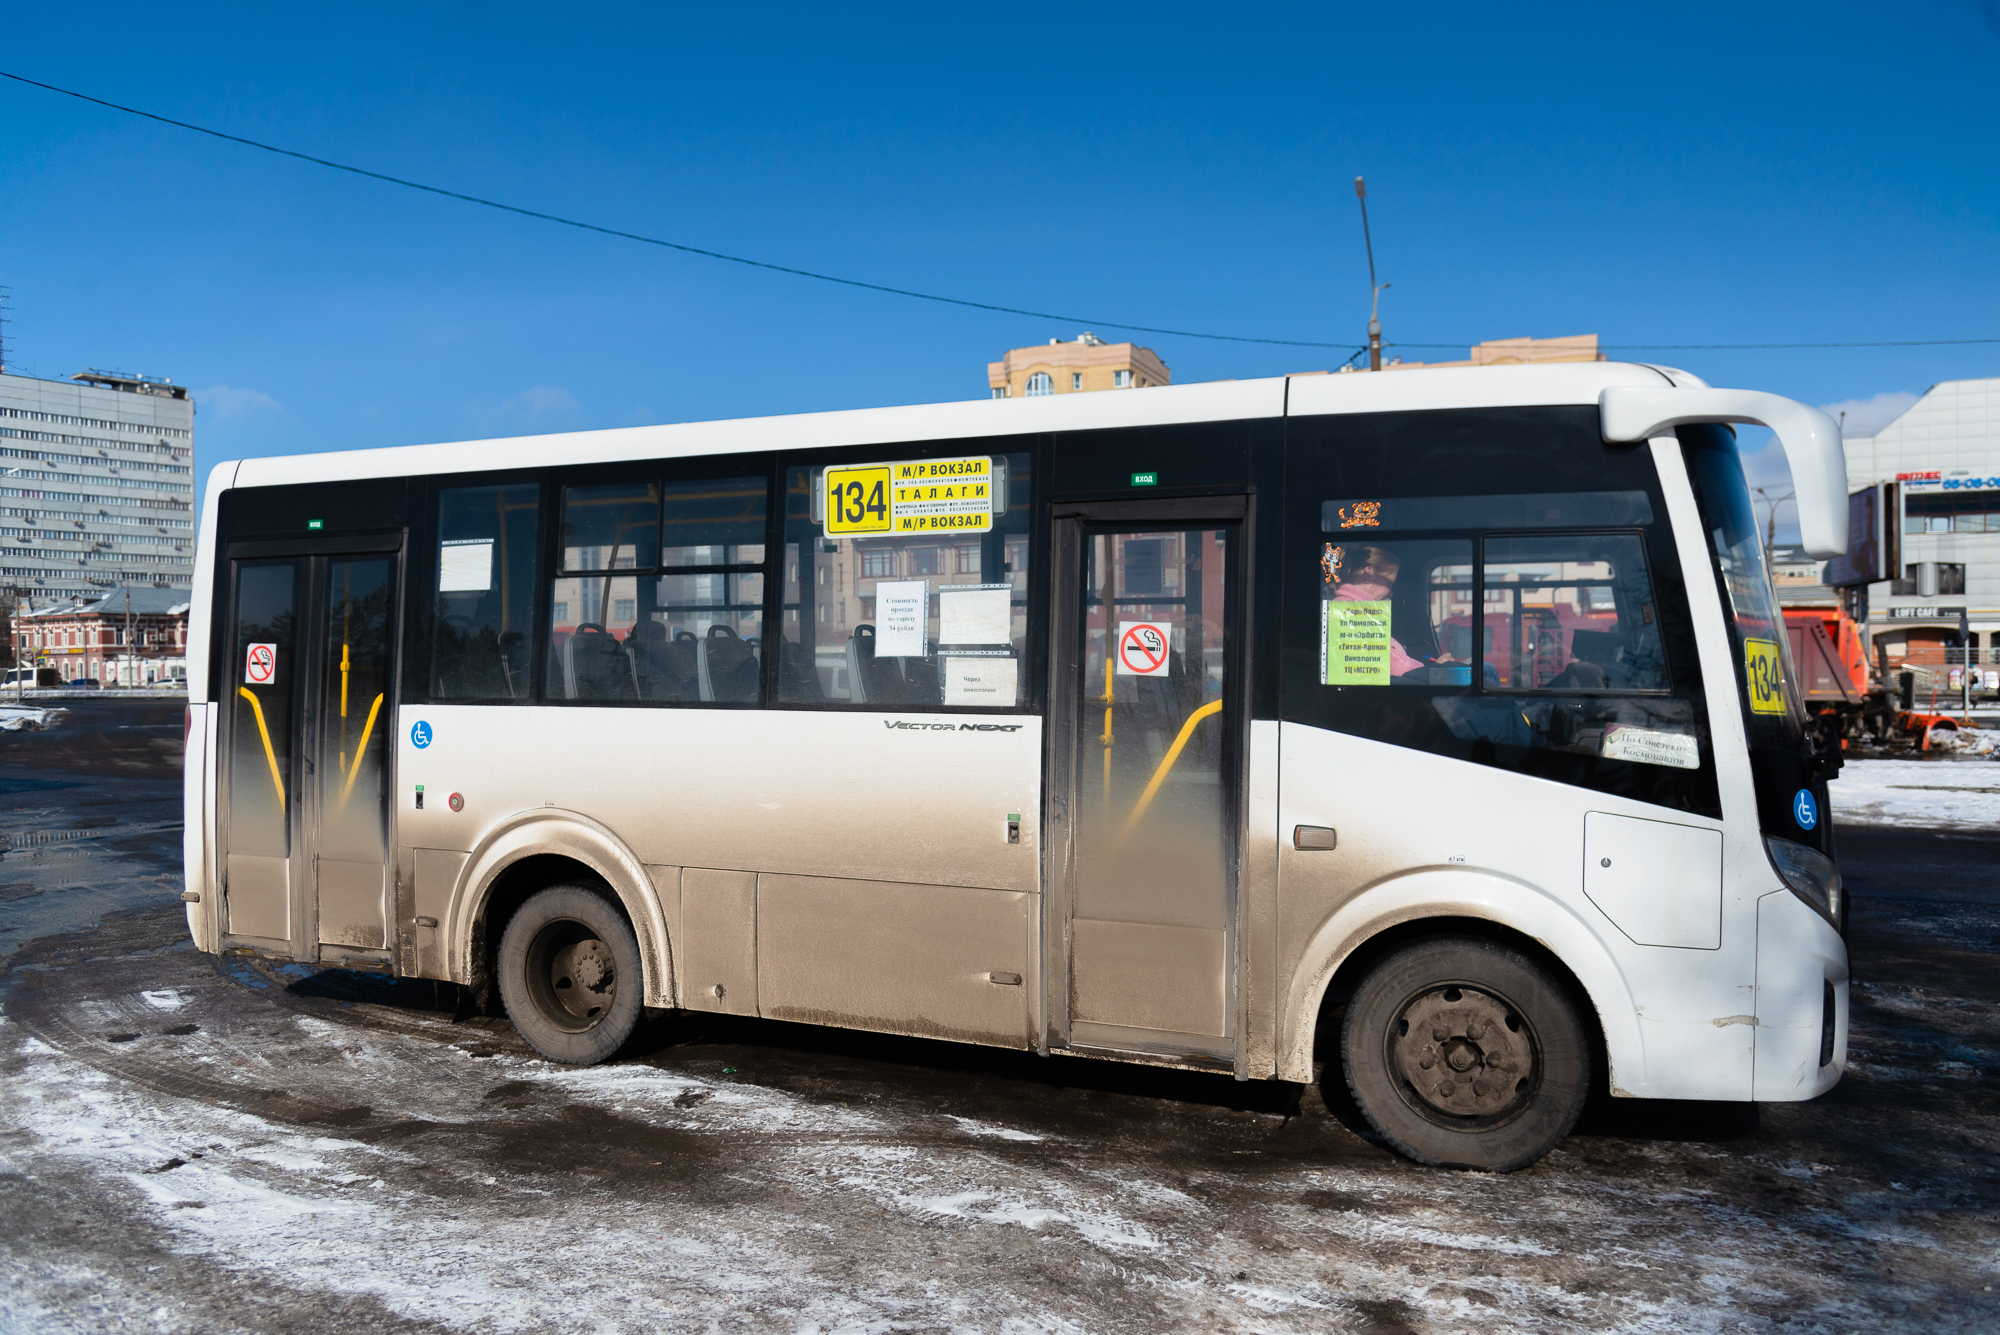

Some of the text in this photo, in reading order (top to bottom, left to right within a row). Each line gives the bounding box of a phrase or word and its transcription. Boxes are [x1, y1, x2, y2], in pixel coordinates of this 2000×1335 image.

[902, 462, 981, 479] М/Р ВОКЗАЛ
[1135, 475, 1153, 483] ВХОД
[900, 485, 984, 500] ТАЛАГИ
[831, 480, 887, 523] 134
[903, 515, 981, 531] М/Р ВОКЗАЛ
[1895, 608, 1916, 617] LOFT
[1339, 643, 1387, 651] «Титан-Арена»
[1354, 666, 1381, 674] «МЕТРО»
[1750, 654, 1782, 702] 134
[959, 723, 1024, 732] NEXT
[1621, 734, 1688, 754] По Советских
[1623, 746, 1685, 765] Космонавтов
